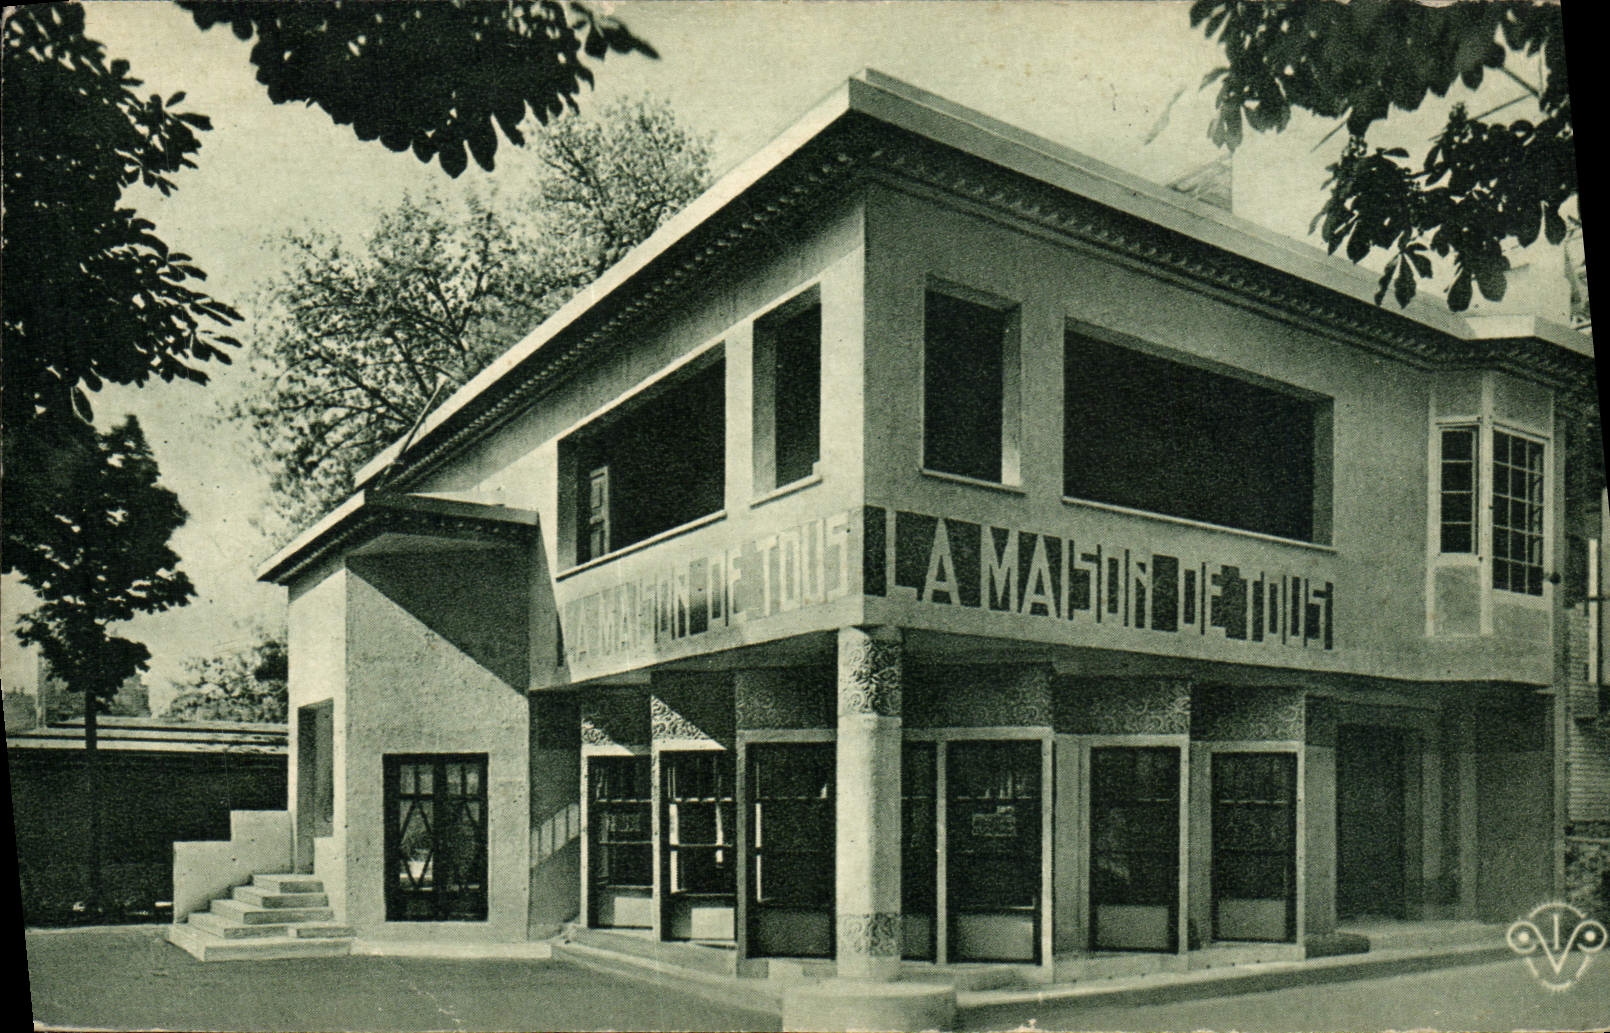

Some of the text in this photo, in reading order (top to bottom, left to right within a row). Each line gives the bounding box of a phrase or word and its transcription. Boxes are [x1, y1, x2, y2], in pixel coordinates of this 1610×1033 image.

[562, 511, 849, 662] LA MAISON DE TOUS
[886, 508, 1326, 648] LA MAISON DE TOUS
